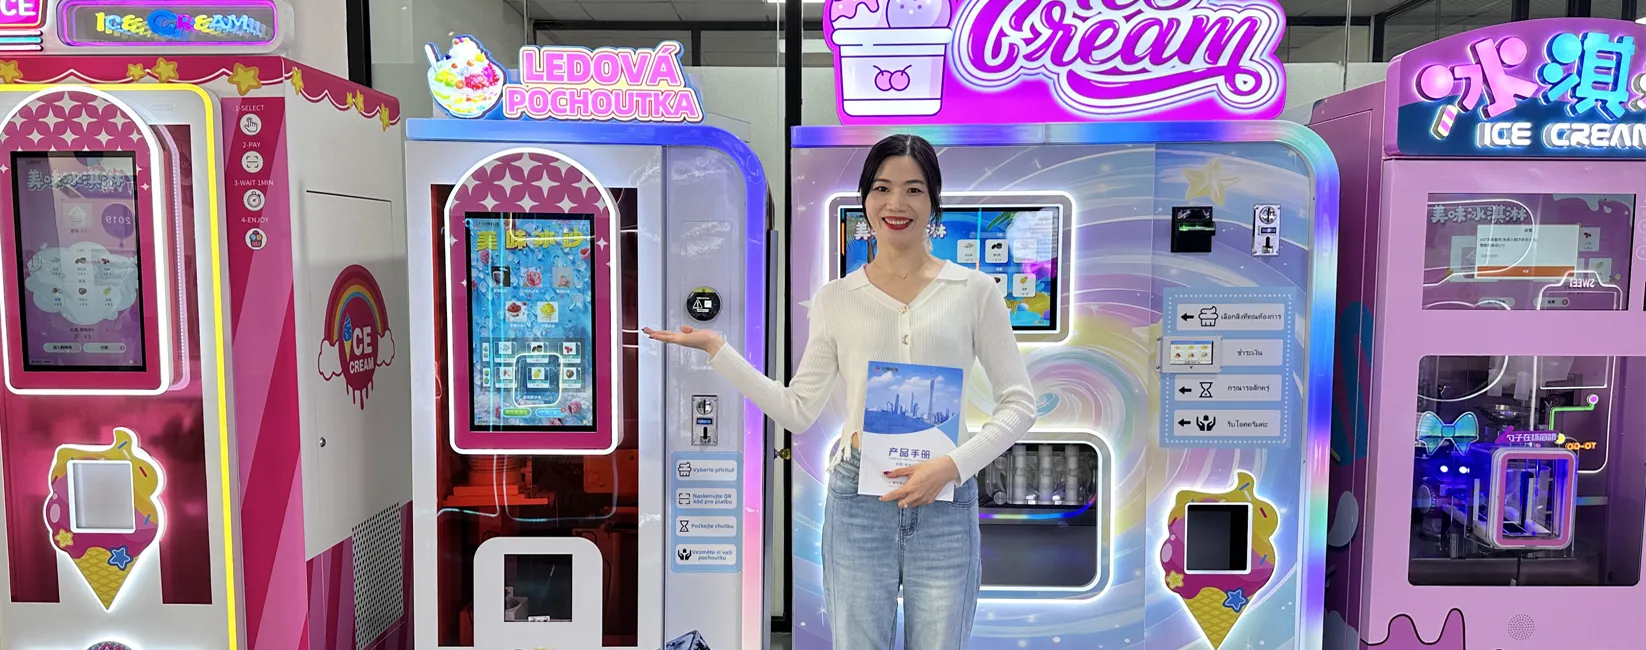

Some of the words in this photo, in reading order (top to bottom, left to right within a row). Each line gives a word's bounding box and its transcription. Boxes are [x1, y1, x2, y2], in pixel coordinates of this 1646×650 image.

[523, 45, 682, 86] LEDOVÁ
[1417, 32, 1646, 119] 冰淇
[235, 104, 265, 112] 1-SELECT
[505, 88, 699, 118] POCHOUTKA
[1480, 122, 1532, 146] ICE
[242, 141, 261, 149] 2-PAY
[234, 179, 256, 187] 3-WAIT
[241, 216, 269, 224] 4-ENJOY
[349, 356, 375, 375] CREAM
[888, 447, 931, 460] 产品手册
